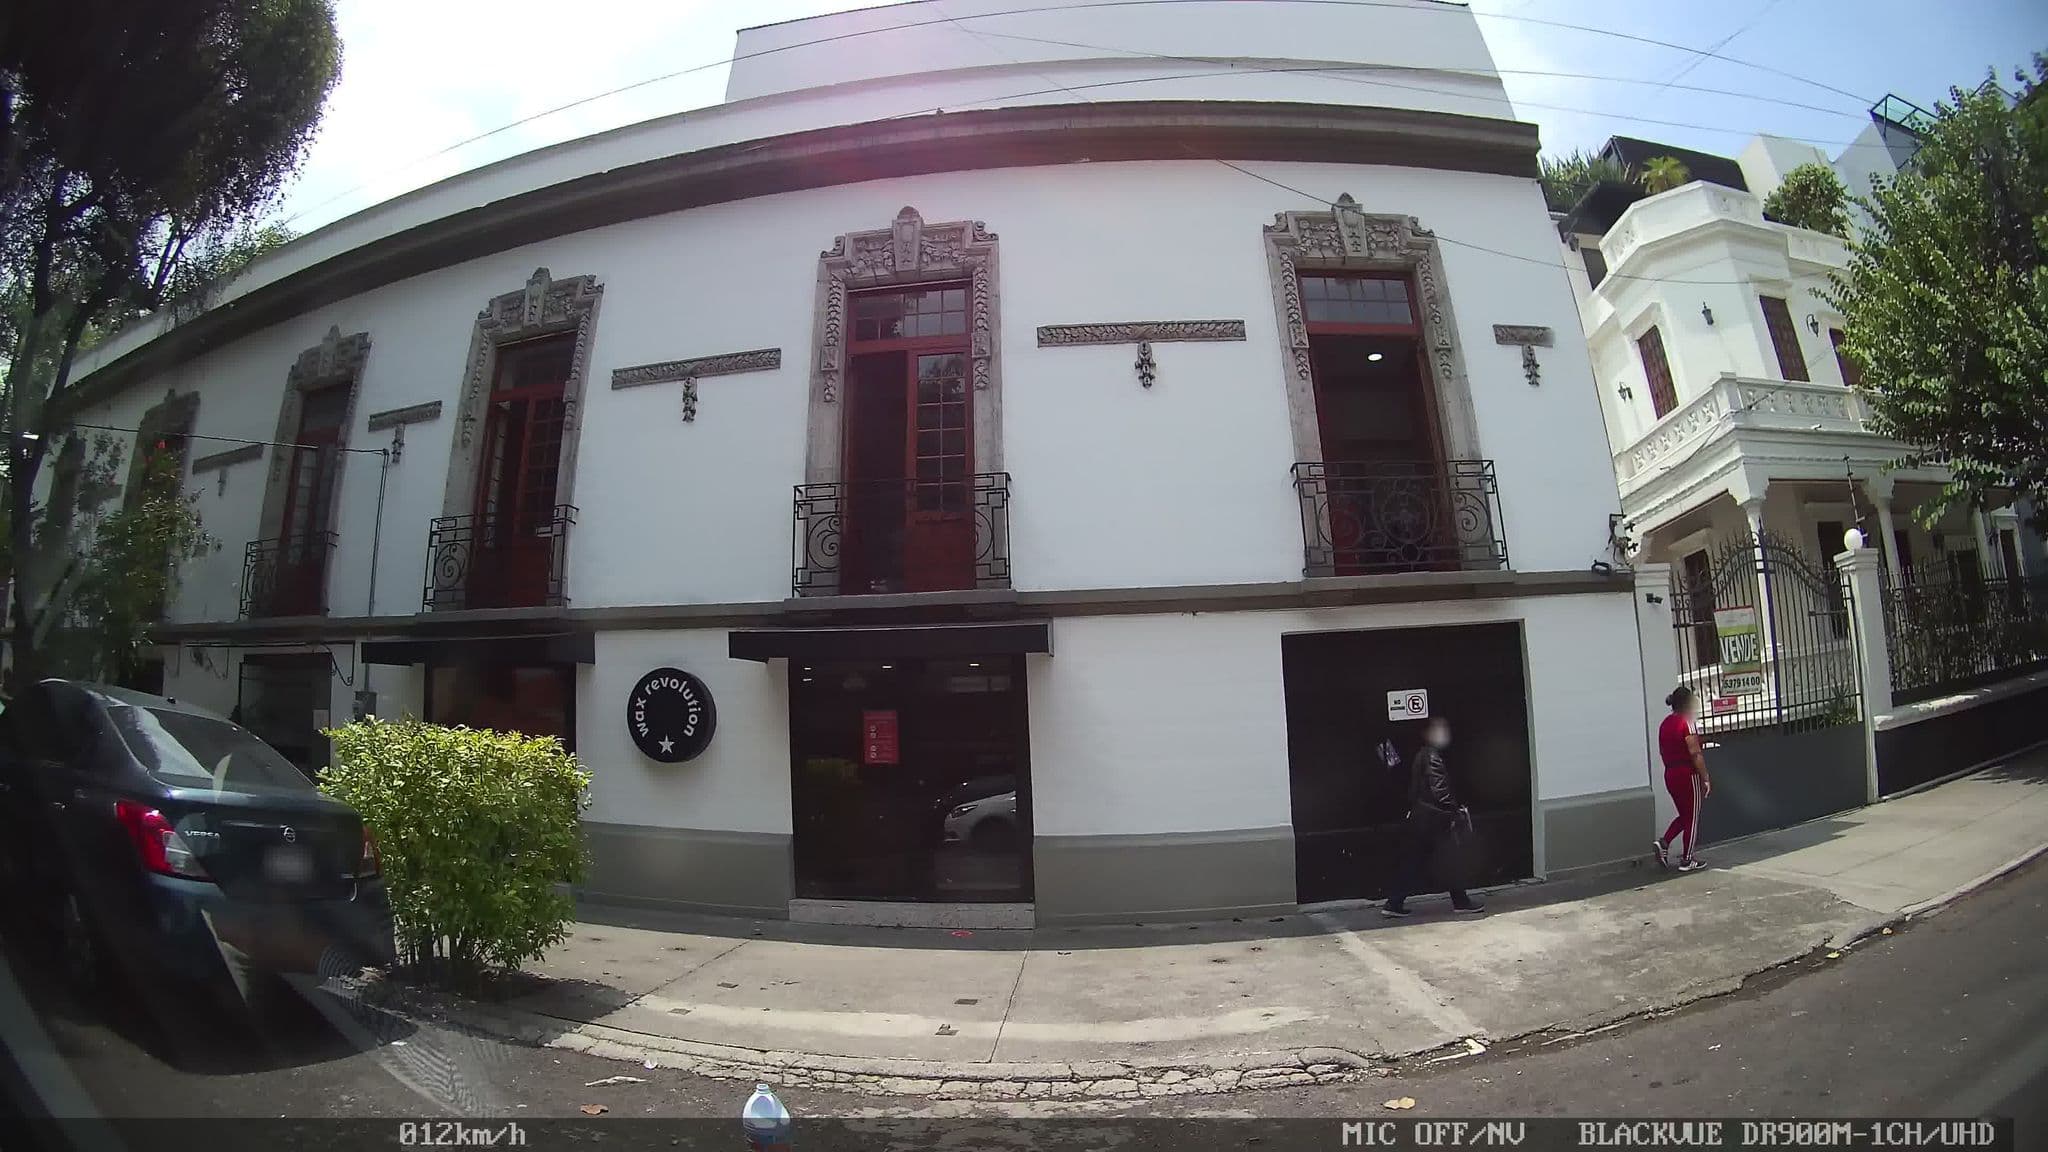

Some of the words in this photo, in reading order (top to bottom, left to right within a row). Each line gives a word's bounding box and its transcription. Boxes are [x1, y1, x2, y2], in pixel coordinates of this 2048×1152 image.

[1719, 632, 1759, 664] VENDE
[635, 697, 649, 737] wax
[645, 677, 701, 737] revolution
